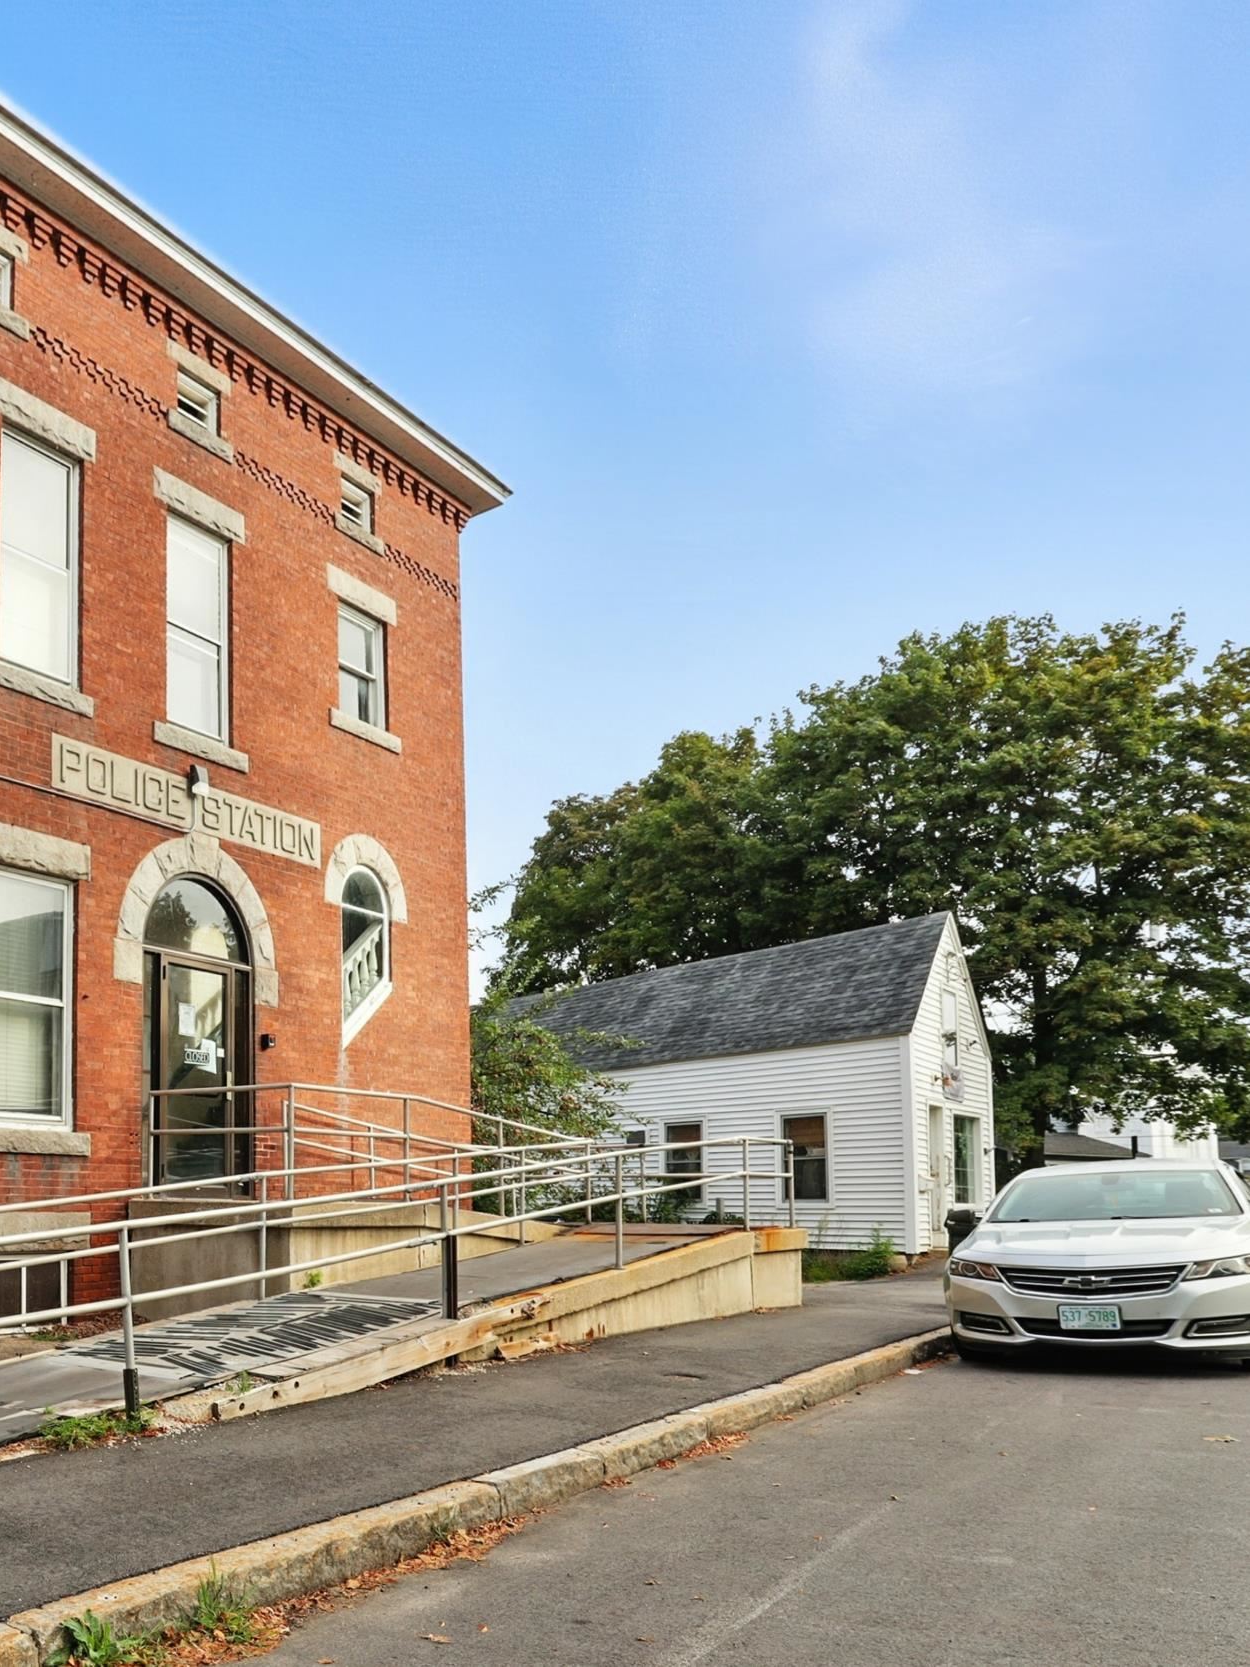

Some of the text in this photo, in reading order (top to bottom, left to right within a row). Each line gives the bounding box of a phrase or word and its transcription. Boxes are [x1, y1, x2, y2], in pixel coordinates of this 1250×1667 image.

[59, 742, 316, 861] POLICE STATION
[185, 1050, 210, 1064] CLOSED
[1062, 1310, 1116, 1322] 537 5789
